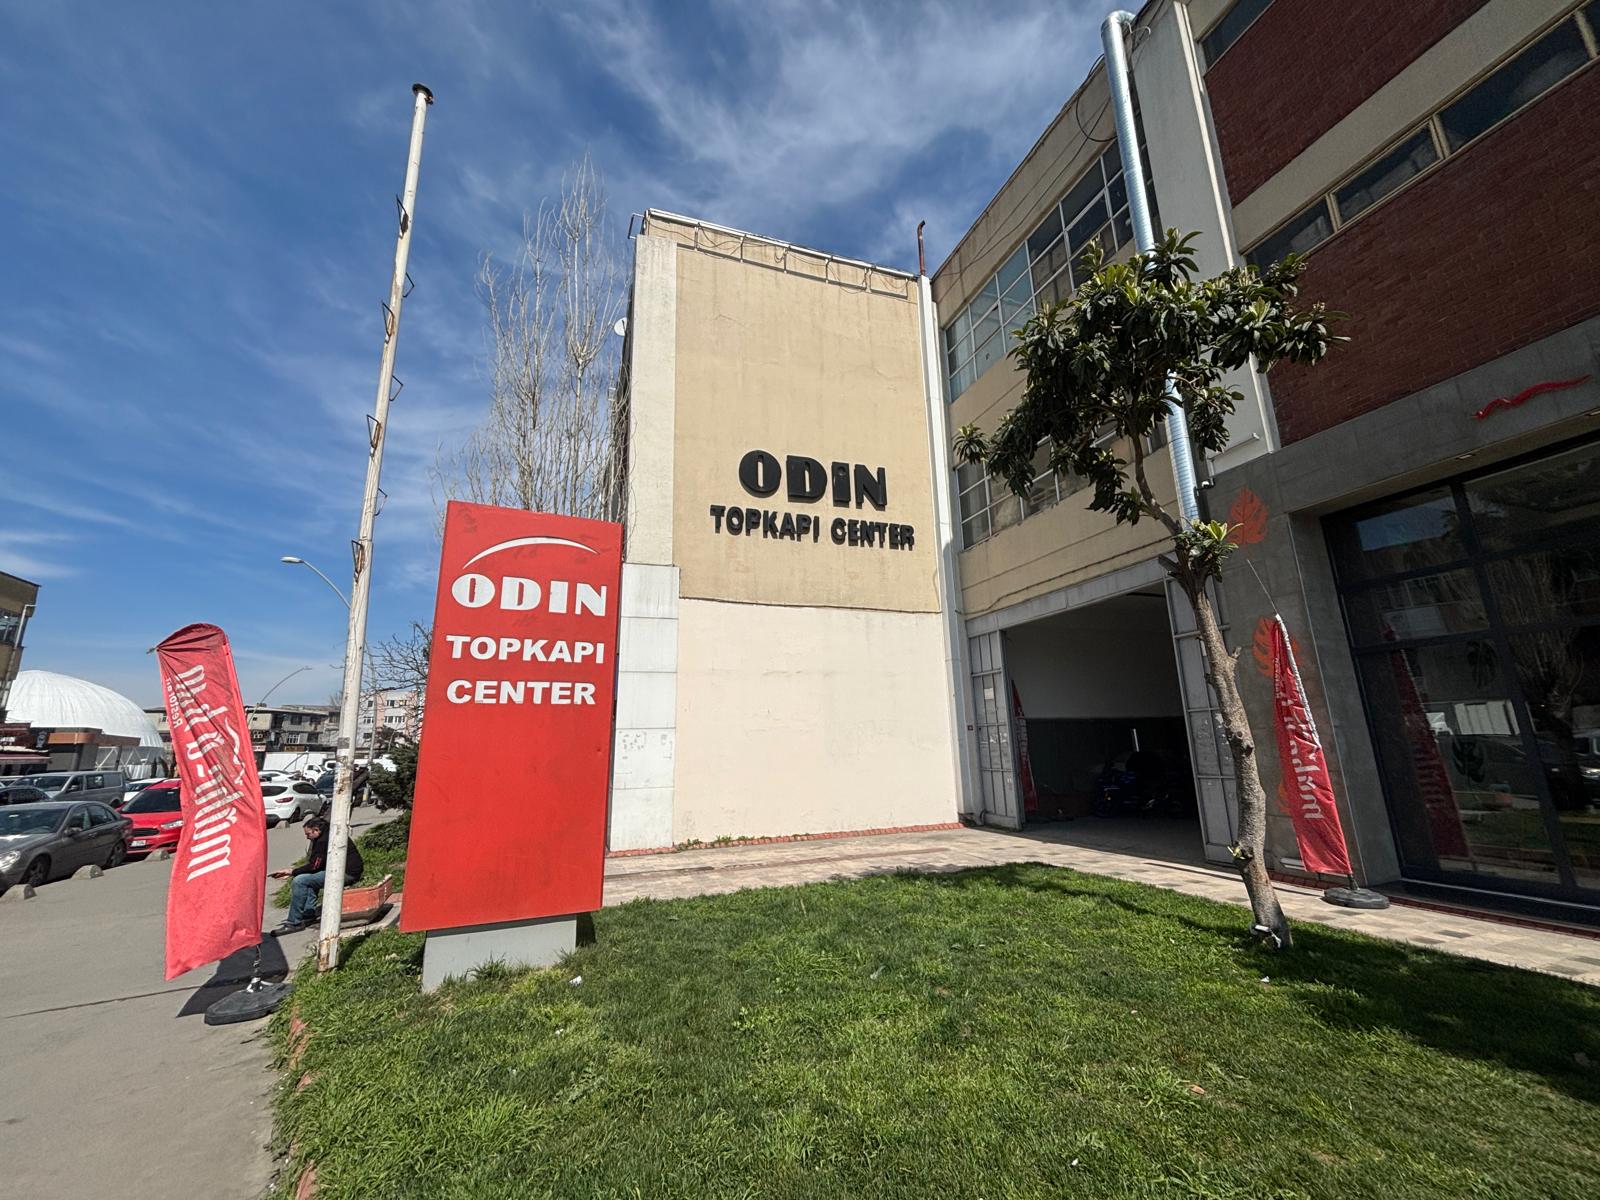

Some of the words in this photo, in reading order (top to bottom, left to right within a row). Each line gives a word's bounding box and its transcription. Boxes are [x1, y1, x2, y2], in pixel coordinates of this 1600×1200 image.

[739, 450, 888, 512] ODIN
[710, 504, 820, 544] TOPKAPI
[831, 517, 915, 551] CENTER
[451, 573, 608, 617] ODIN
[445, 634, 605, 665] TOPKAPI
[446, 679, 597, 705] CENTER
